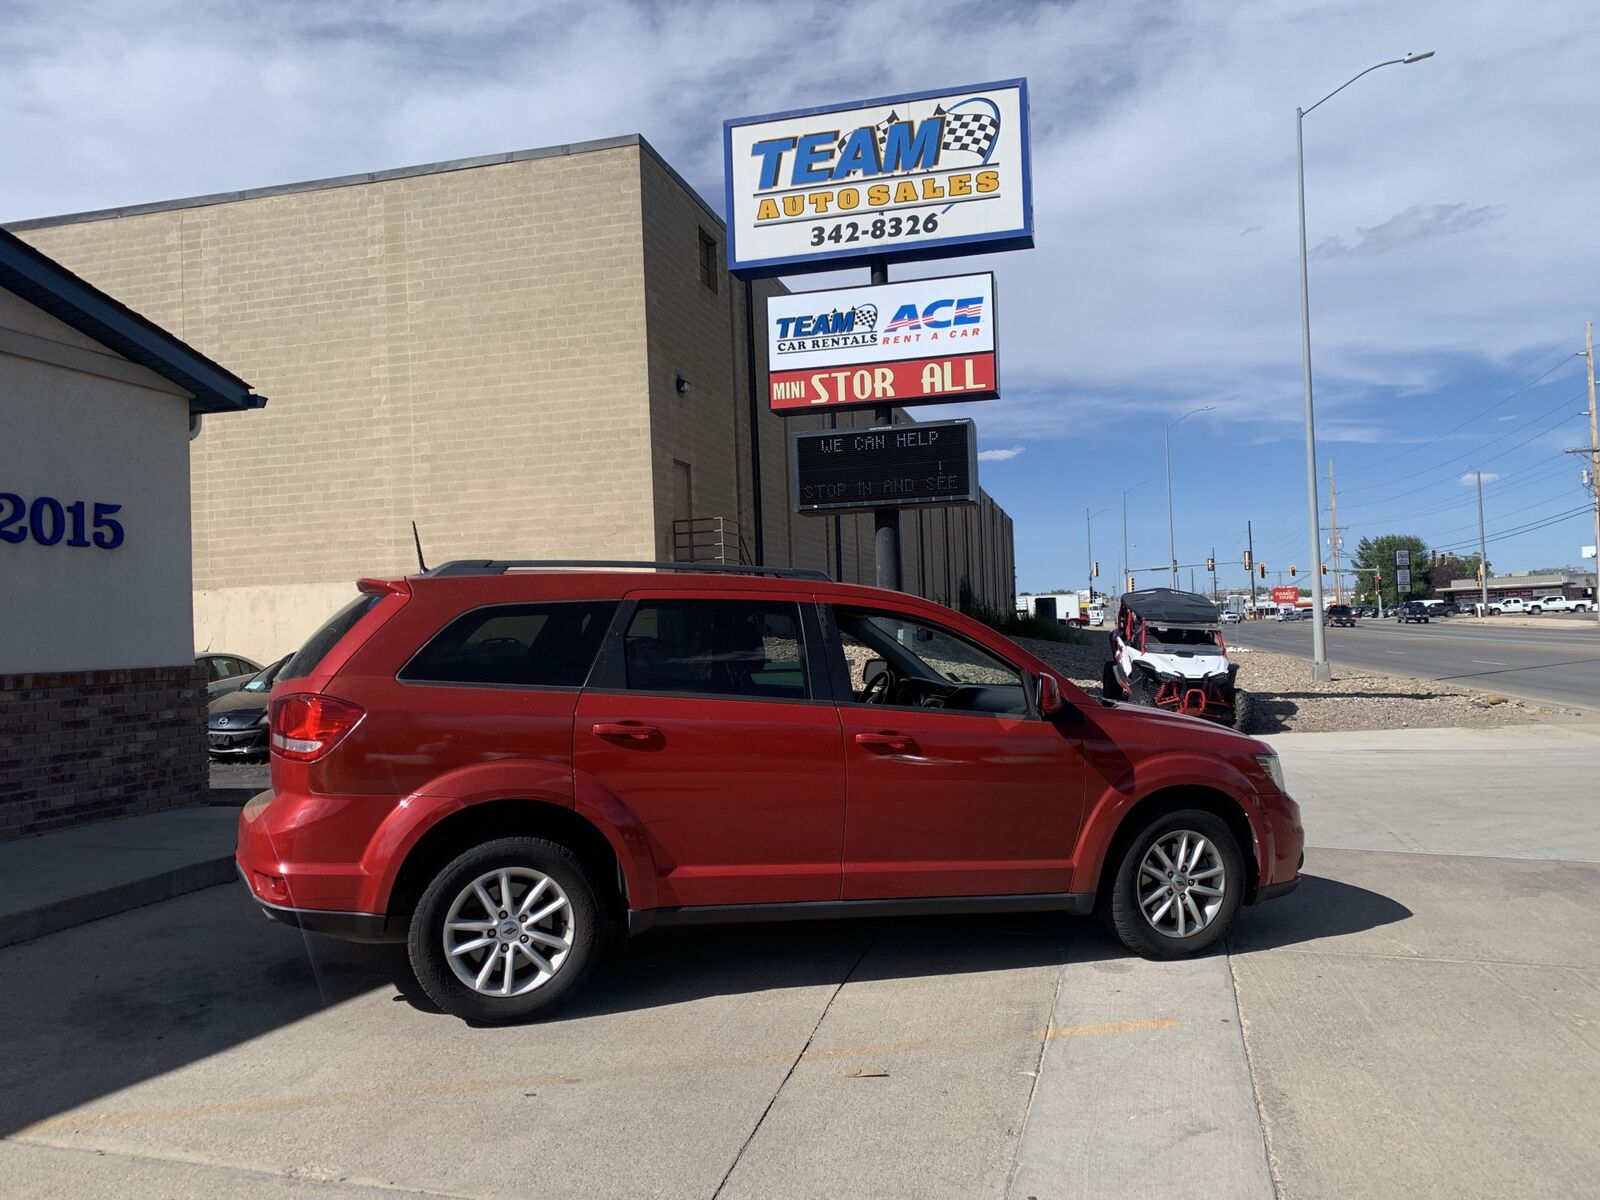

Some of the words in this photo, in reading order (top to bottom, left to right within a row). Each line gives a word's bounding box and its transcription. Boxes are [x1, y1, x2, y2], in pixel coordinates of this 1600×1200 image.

[751, 115, 947, 190] TEAM
[757, 187, 860, 221] AUTO
[867, 170, 1000, 206] SALES
[810, 212, 939, 247] 342-8326
[776, 310, 856, 339] TEAM
[883, 296, 984, 333] ACE
[777, 341, 807, 352] CAR
[811, 333, 878, 349] RENTALS
[882, 333, 922, 345] RENT
[931, 332, 939, 341] A
[949, 327, 981, 338] CAR
[772, 380, 806, 400] MINI
[810, 367, 896, 404] STOR
[920, 359, 986, 394] ALL
[821, 438, 843, 453] WE
[854, 434, 885, 451] CAN
[896, 430, 939, 448] HELP
[804, 481, 848, 499] STOP
[883, 477, 914, 494] AND
[926, 474, 958, 491] SEE
[0, 492, 125, 550] 2015
